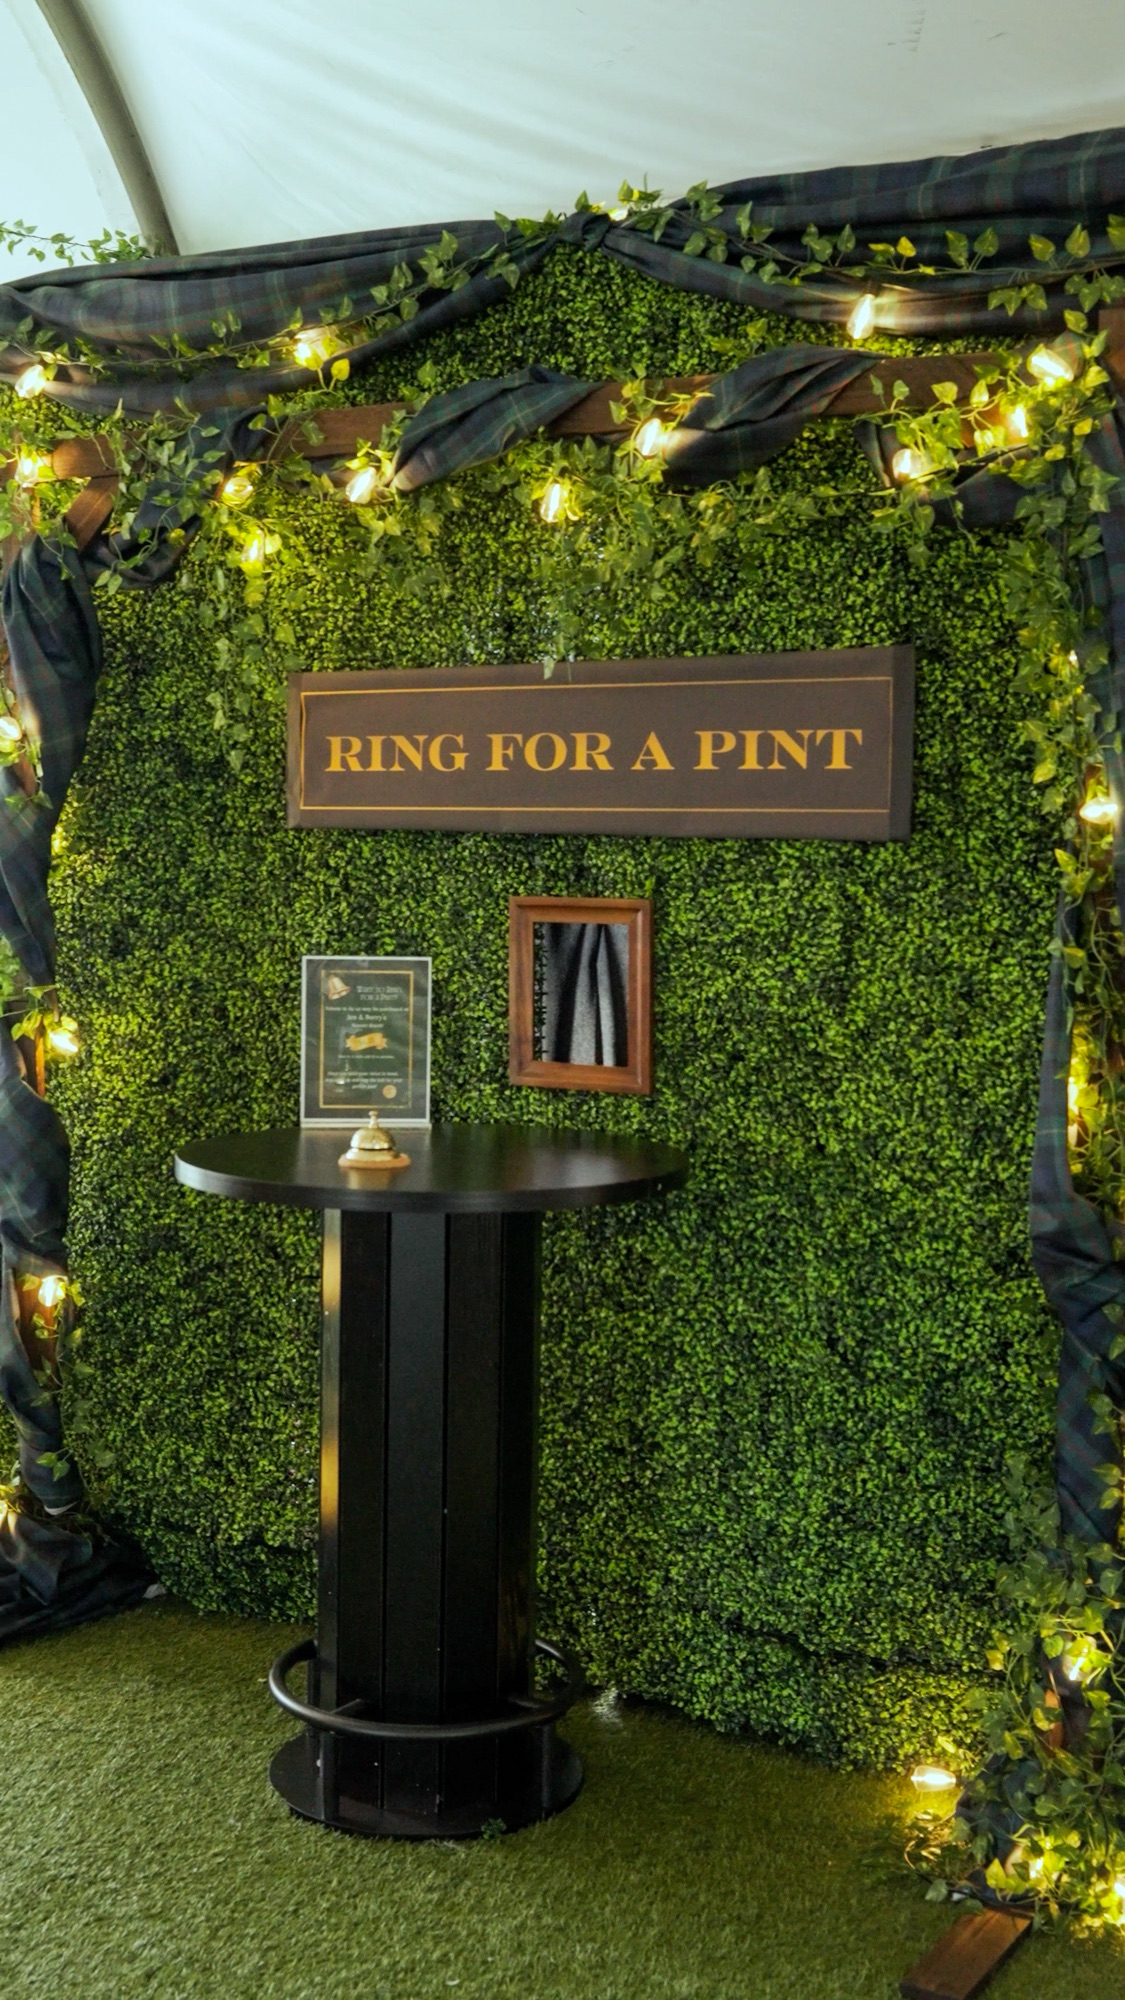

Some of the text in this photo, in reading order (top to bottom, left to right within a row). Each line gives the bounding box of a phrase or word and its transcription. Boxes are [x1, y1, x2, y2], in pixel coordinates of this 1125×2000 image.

[325, 728, 863, 773] RING FOR A PINT
